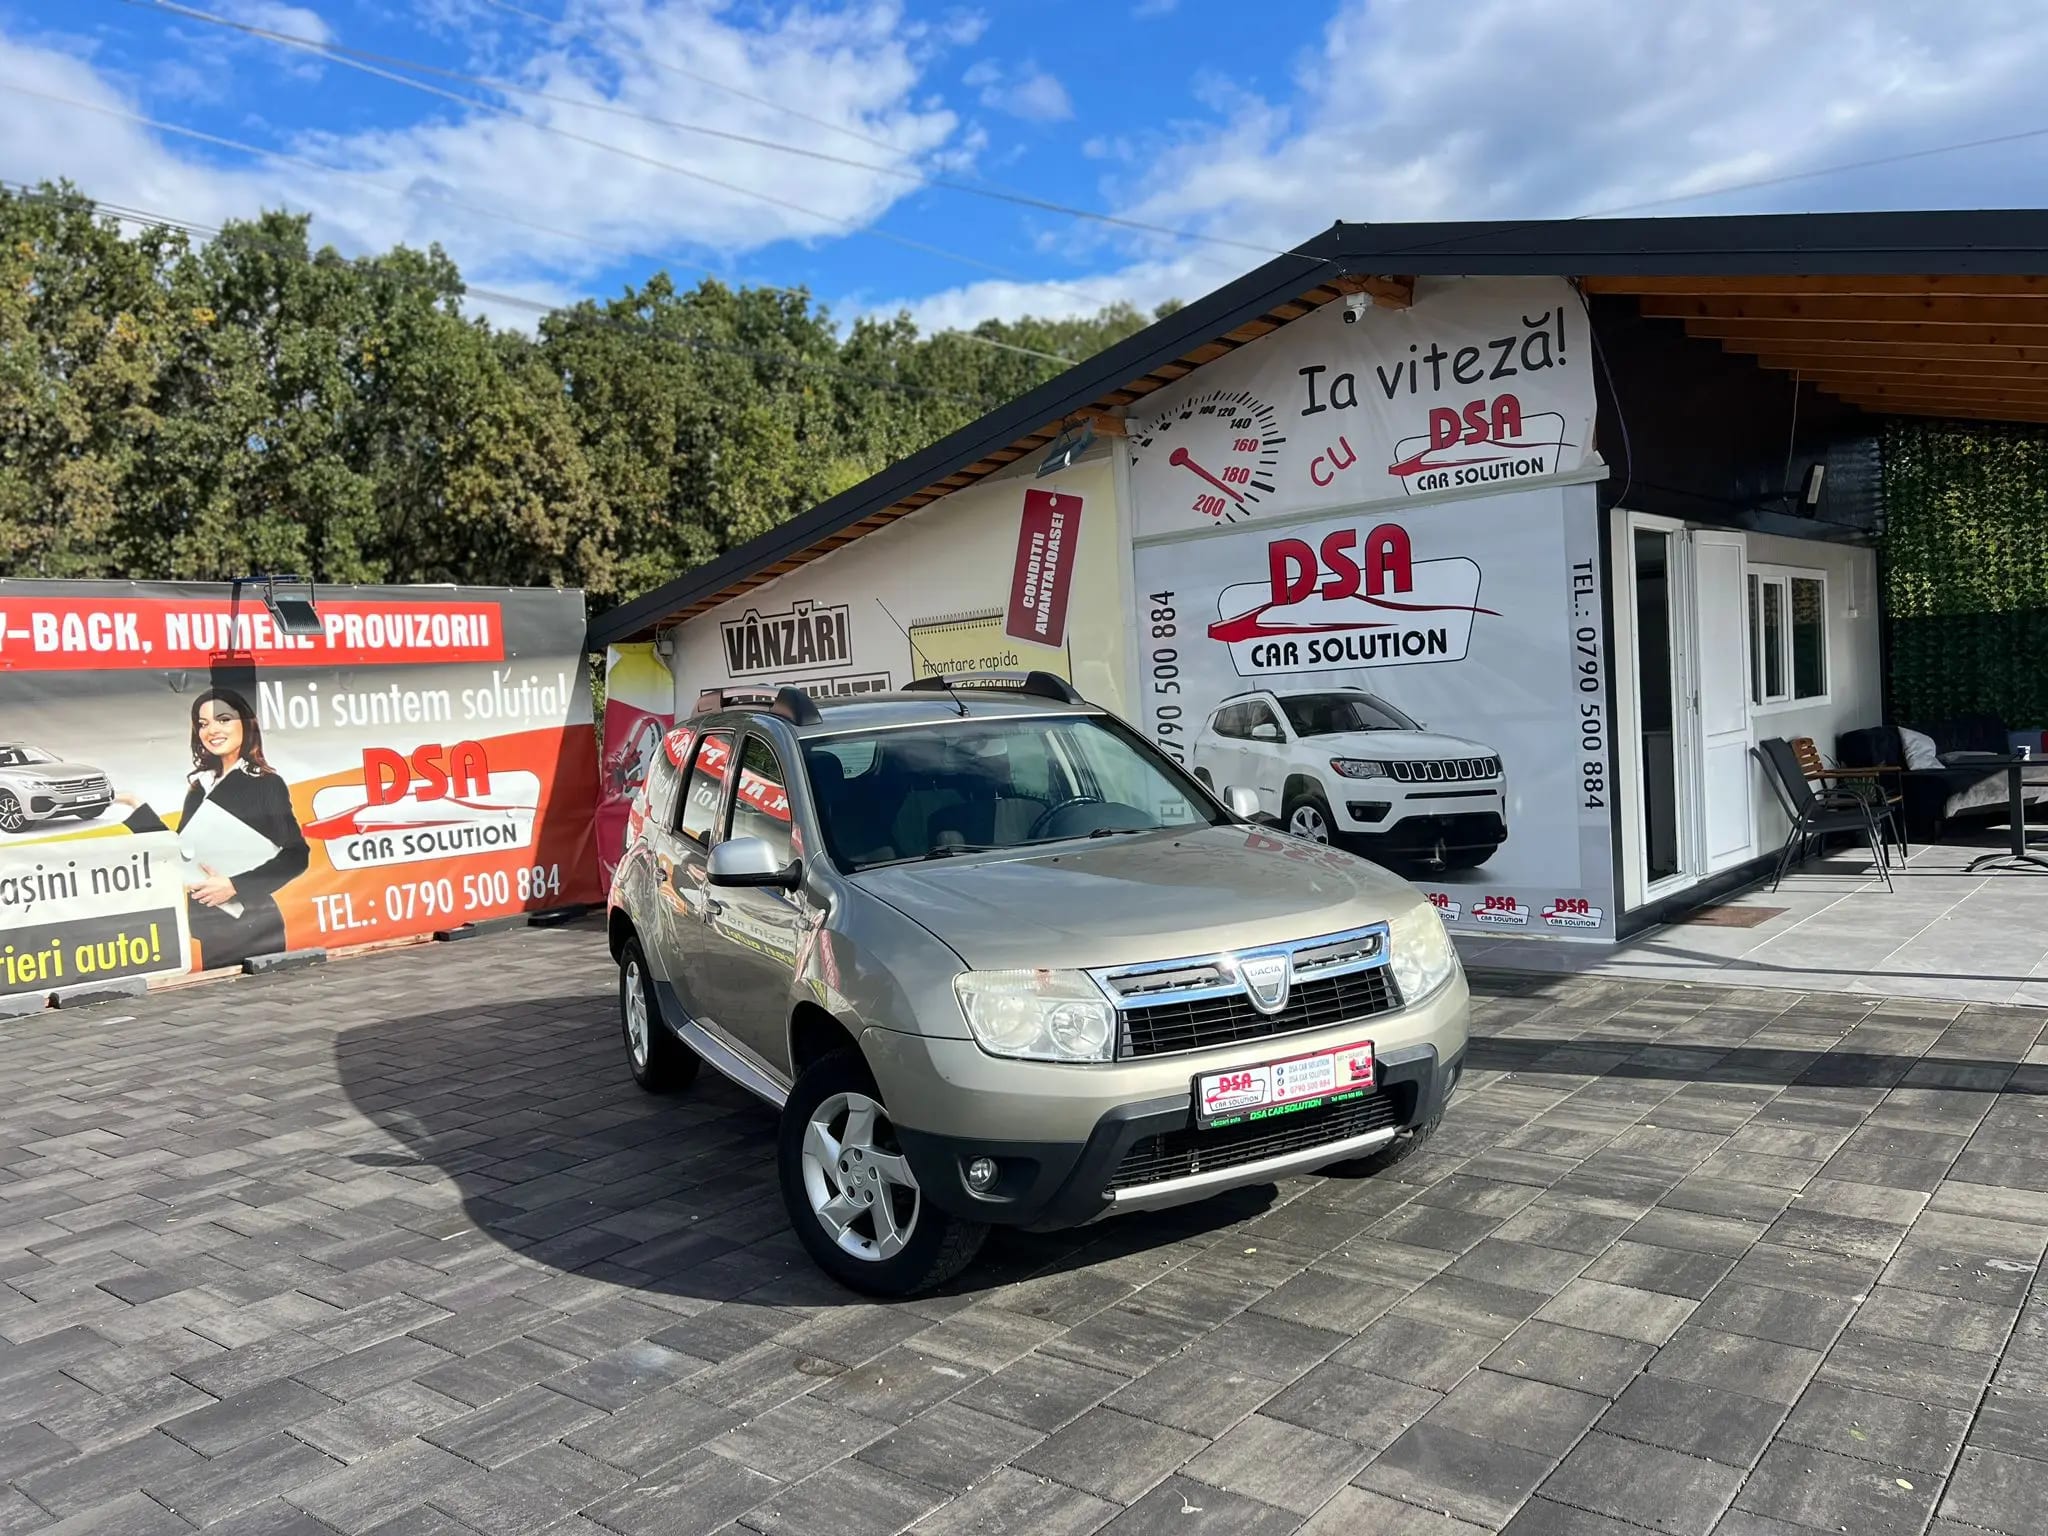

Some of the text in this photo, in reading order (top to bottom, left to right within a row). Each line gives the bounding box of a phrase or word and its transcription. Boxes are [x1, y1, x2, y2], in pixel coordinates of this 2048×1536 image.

[1299, 306, 1566, 416] Ia viteză!
[1216, 406, 1236, 417] 120
[1229, 417, 1252, 429] 140
[1429, 394, 1522, 450] DSA
[1232, 438, 1258, 452] 160
[1311, 435, 1357, 486] cu
[1221, 465, 1249, 484] 180
[1417, 456, 1544, 491] CAR SOLUTION
[1191, 494, 1226, 517] 200
[1023, 532, 1045, 609] CONDITII
[1035, 512, 1065, 635] AVANTAJOASE!
[1268, 523, 1413, 606] DSA
[324, 613, 489, 649] PROVIZORII
[1150, 590, 1177, 639] 884
[725, 607, 848, 671] VÂNZĂRI
[1251, 628, 1448, 668] CAR SOLUTION
[1576, 627, 1599, 692] 0790
[979, 650, 1019, 671] rapida
[1152, 648, 1181, 694] 500
[258, 681, 320, 730] Noi
[331, 683, 451, 726] suntem
[1580, 703, 1602, 751] 500
[362, 740, 491, 806] DSA
[1583, 761, 1604, 809] 884
[347, 823, 517, 861] CAR SOLUTION
[91, 851, 152, 895] noi!
[385, 878, 453, 922] 0790
[463, 870, 509, 911] 500
[517, 864, 560, 901] 884
[1424, 893, 1448, 907] SA
[1485, 896, 1516, 911] DSA
[1555, 898, 1589, 913] DSA
[75, 923, 161, 973] auto!
[1250, 966, 1281, 977] DACIA
[1215, 1095, 1259, 1108] CAR SOLUTION
[1219, 1073, 1252, 1092] DSA
[1250, 1109, 1267, 1120] DSA
[1268, 1106, 1284, 1117] CAR
[1284, 1098, 1322, 1113] SOLUTION
